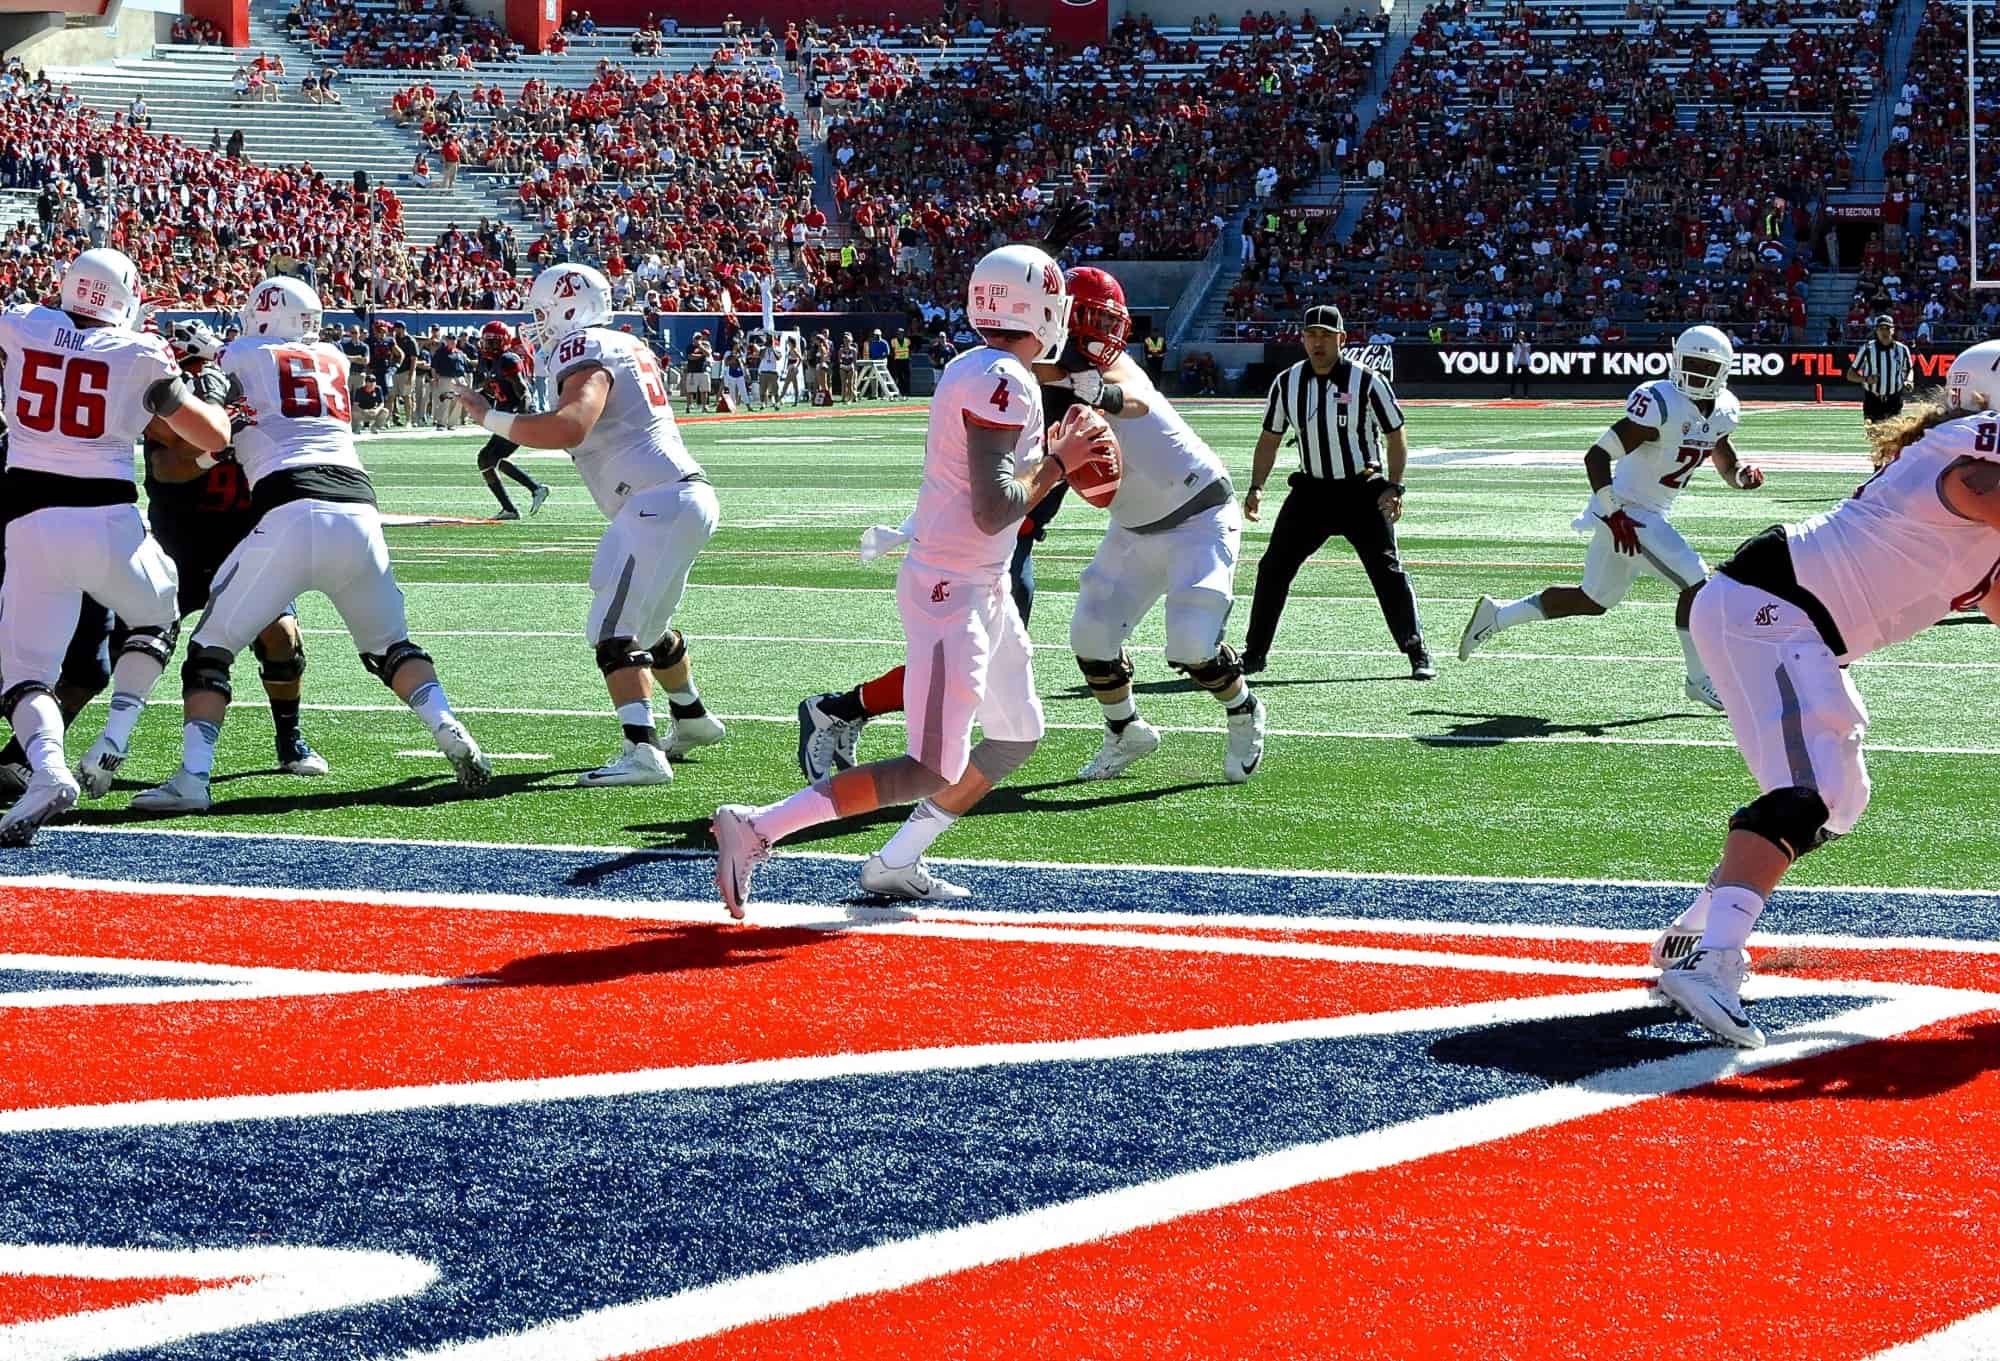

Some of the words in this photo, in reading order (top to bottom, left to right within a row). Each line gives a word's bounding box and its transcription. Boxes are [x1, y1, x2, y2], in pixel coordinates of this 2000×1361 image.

[1846, 208, 1872, 216] SECTION
[90, 291, 106, 307] 56
[988, 297, 997, 312] 4
[54, 327, 86, 351] DAHL
[559, 336, 586, 363] 58
[1438, 351, 1500, 375] YOU
[1727, 352, 1785, 376] ERO
[1791, 353, 1843, 377] 'TIL
[16, 347, 110, 440] 56
[272, 349, 352, 424] 63
[989, 376, 1010, 413] 4
[1626, 391, 1653, 418] 25
[1338, 415, 1348, 427] U
